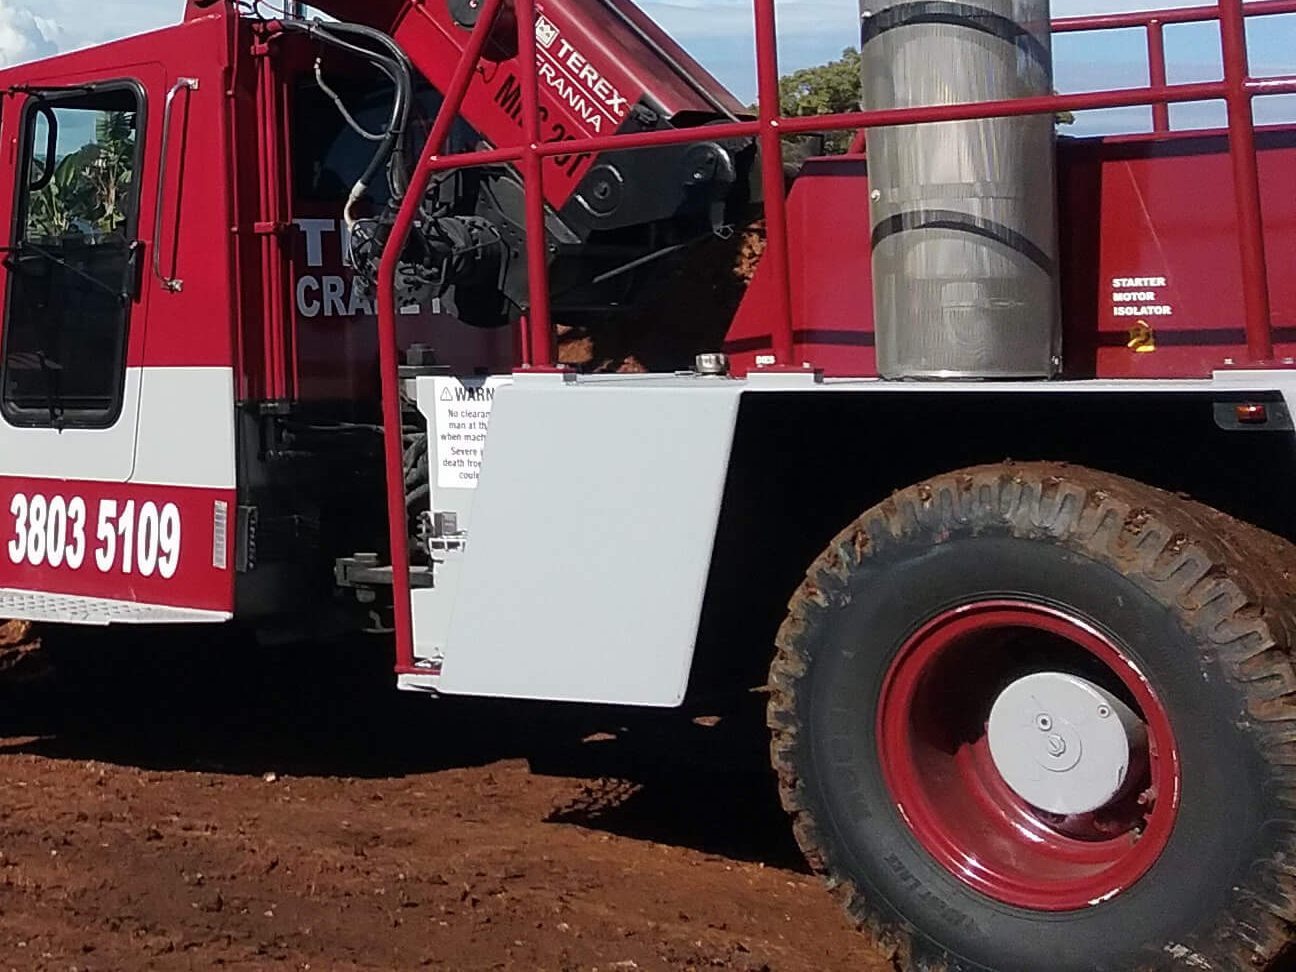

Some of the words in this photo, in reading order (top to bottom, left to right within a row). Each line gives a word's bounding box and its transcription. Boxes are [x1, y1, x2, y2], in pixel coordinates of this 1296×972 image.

[556, 39, 628, 116] TEREX
[1112, 277, 1167, 288] STARTER
[1112, 291, 1155, 302] MOTOR
[1113, 305, 1172, 316] ISOLATOR
[448, 409, 459, 418] No
[448, 421, 466, 429] man
[468, 421, 476, 429] at
[440, 432, 462, 441] when
[450, 447, 477, 456] Severe
[443, 459, 465, 467] death
[8, 493, 87, 569] 3803
[95, 499, 181, 579] 5109
